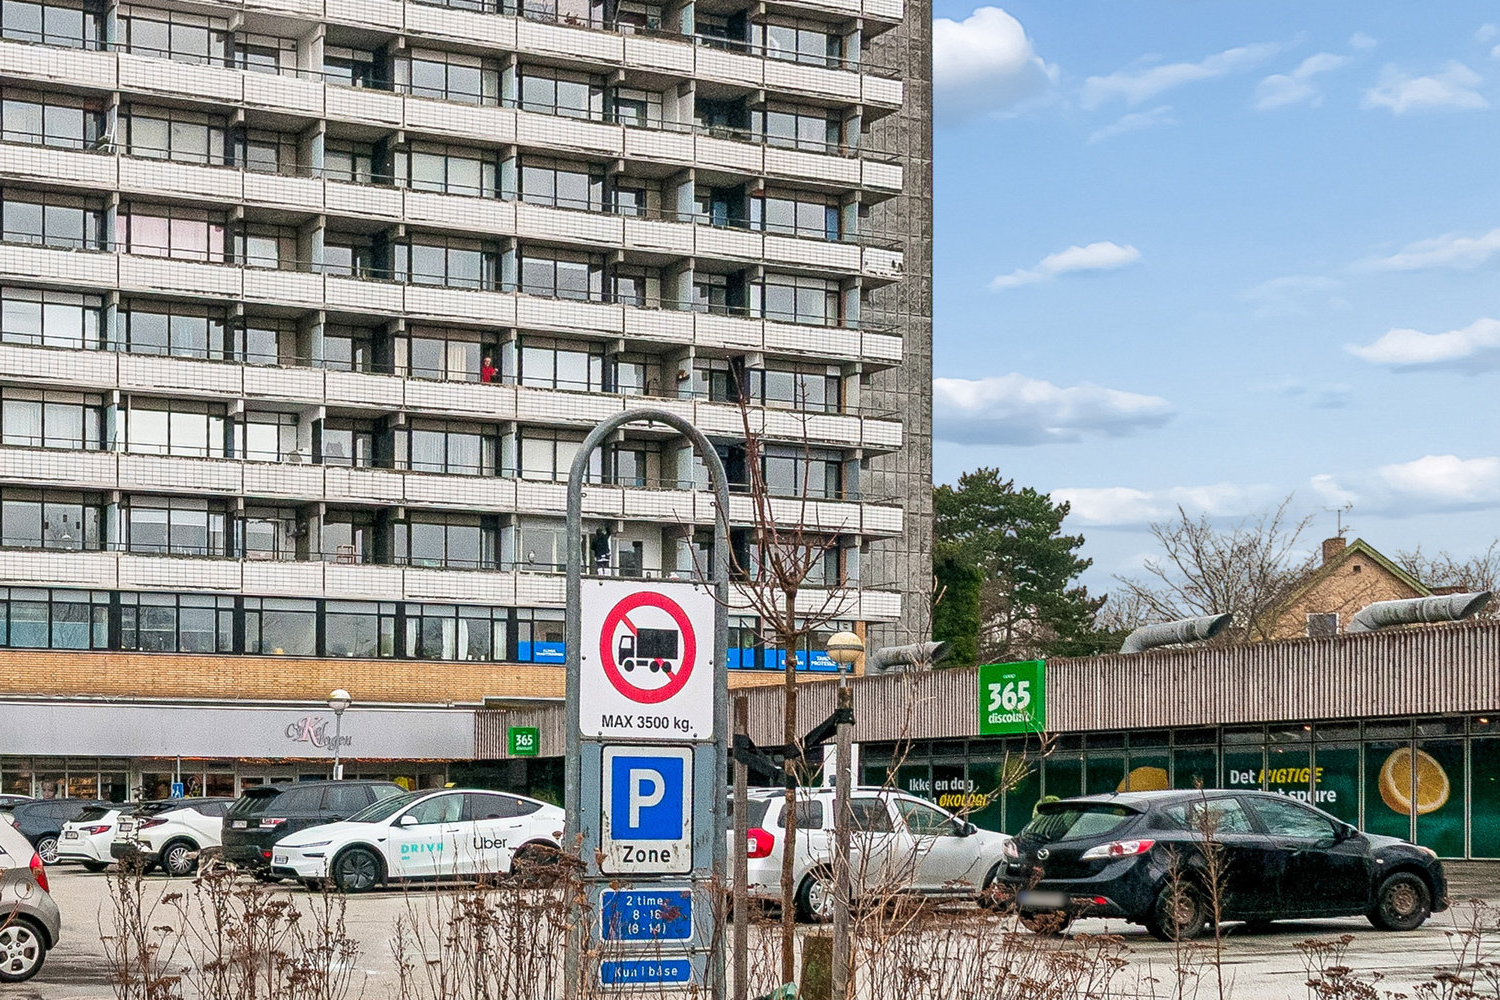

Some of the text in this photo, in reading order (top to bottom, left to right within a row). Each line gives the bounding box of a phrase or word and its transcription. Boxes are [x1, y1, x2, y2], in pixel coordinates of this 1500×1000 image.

[987, 681, 1031, 712] 365
[601, 714, 694, 733] MAX 3500 kg.
[988, 712, 1031, 724] discount
[515, 734, 534, 746] 365
[909, 777, 974, 793] Ikke en dag
[1230, 769, 1256, 785] Det
[629, 768, 666, 829] P
[473, 837, 508, 850] Uber
[622, 846, 671, 863] Zone
[626, 895, 633, 906] 2
